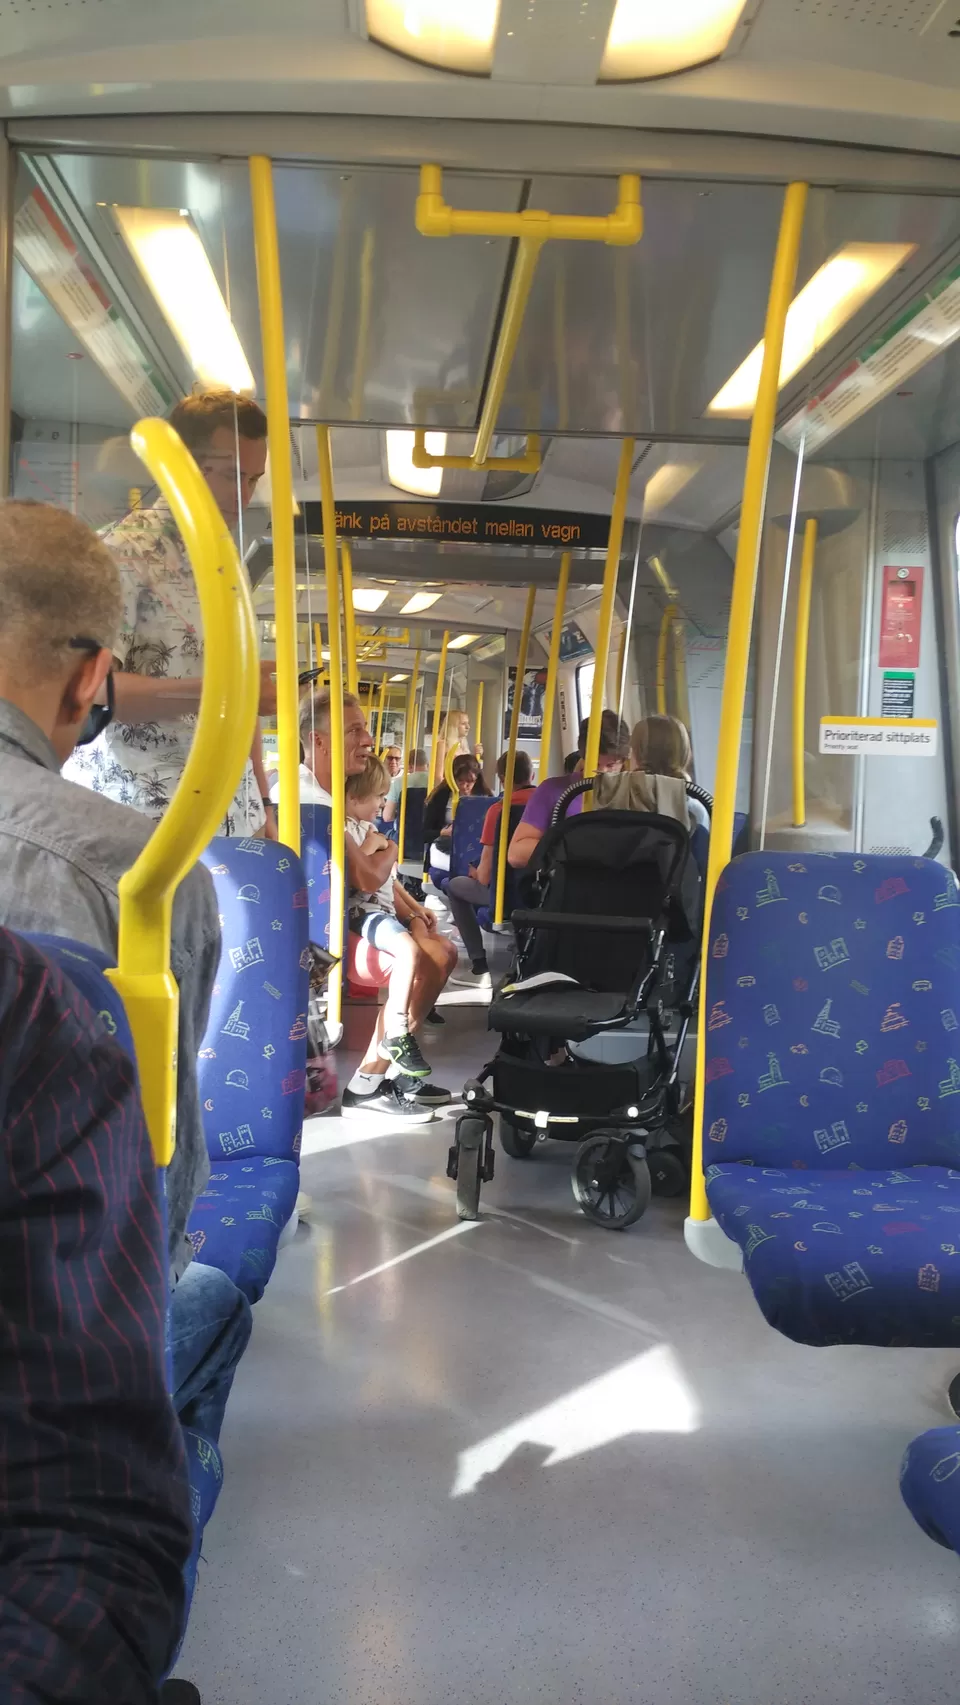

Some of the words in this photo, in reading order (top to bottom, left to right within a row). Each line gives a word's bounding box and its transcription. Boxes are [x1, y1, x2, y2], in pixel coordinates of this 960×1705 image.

[335, 511, 362, 529] änk
[370, 513, 390, 533] på
[396, 515, 478, 534] avståndet
[485, 519, 534, 537] mellan
[541, 523, 581, 542] vagn
[824, 729, 883, 742] Prioriterad
[885, 731, 931, 744] sittplats
